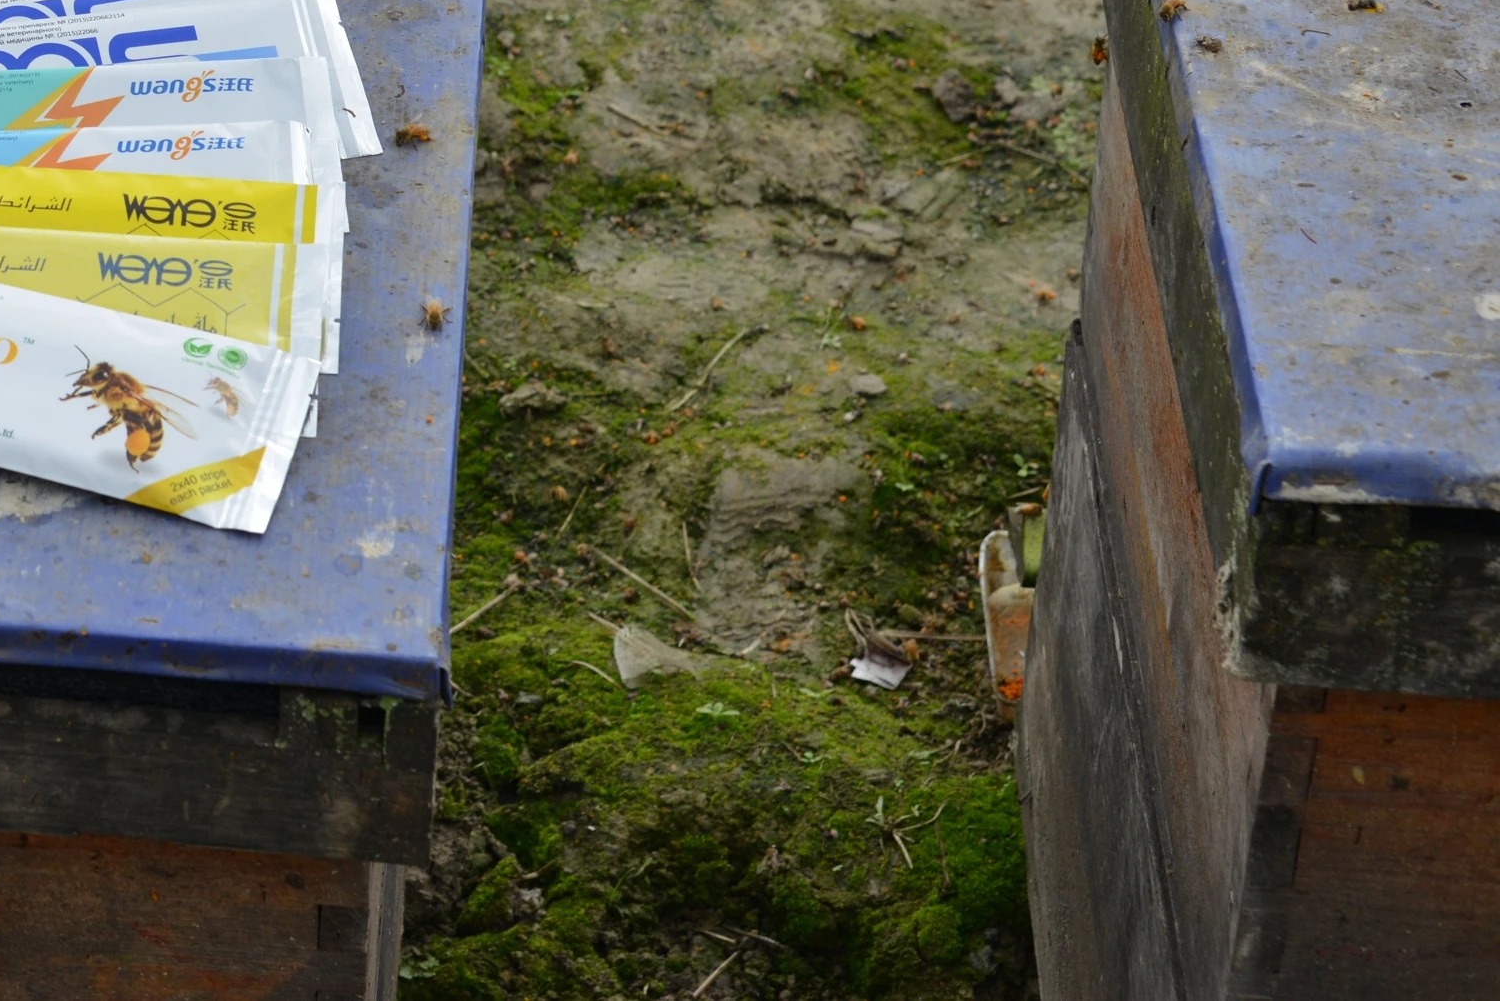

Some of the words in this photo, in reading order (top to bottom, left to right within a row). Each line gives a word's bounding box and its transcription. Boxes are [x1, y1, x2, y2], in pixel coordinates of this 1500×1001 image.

[6, 34, 45, 46] медицины
[223, 218, 255, 235] 汪氏
[198, 276, 233, 291] 汪氏
[169, 474, 198, 492] 2x40
[198, 469, 227, 482] strips
[169, 488, 197, 506] each
[198, 479, 233, 496] packet
